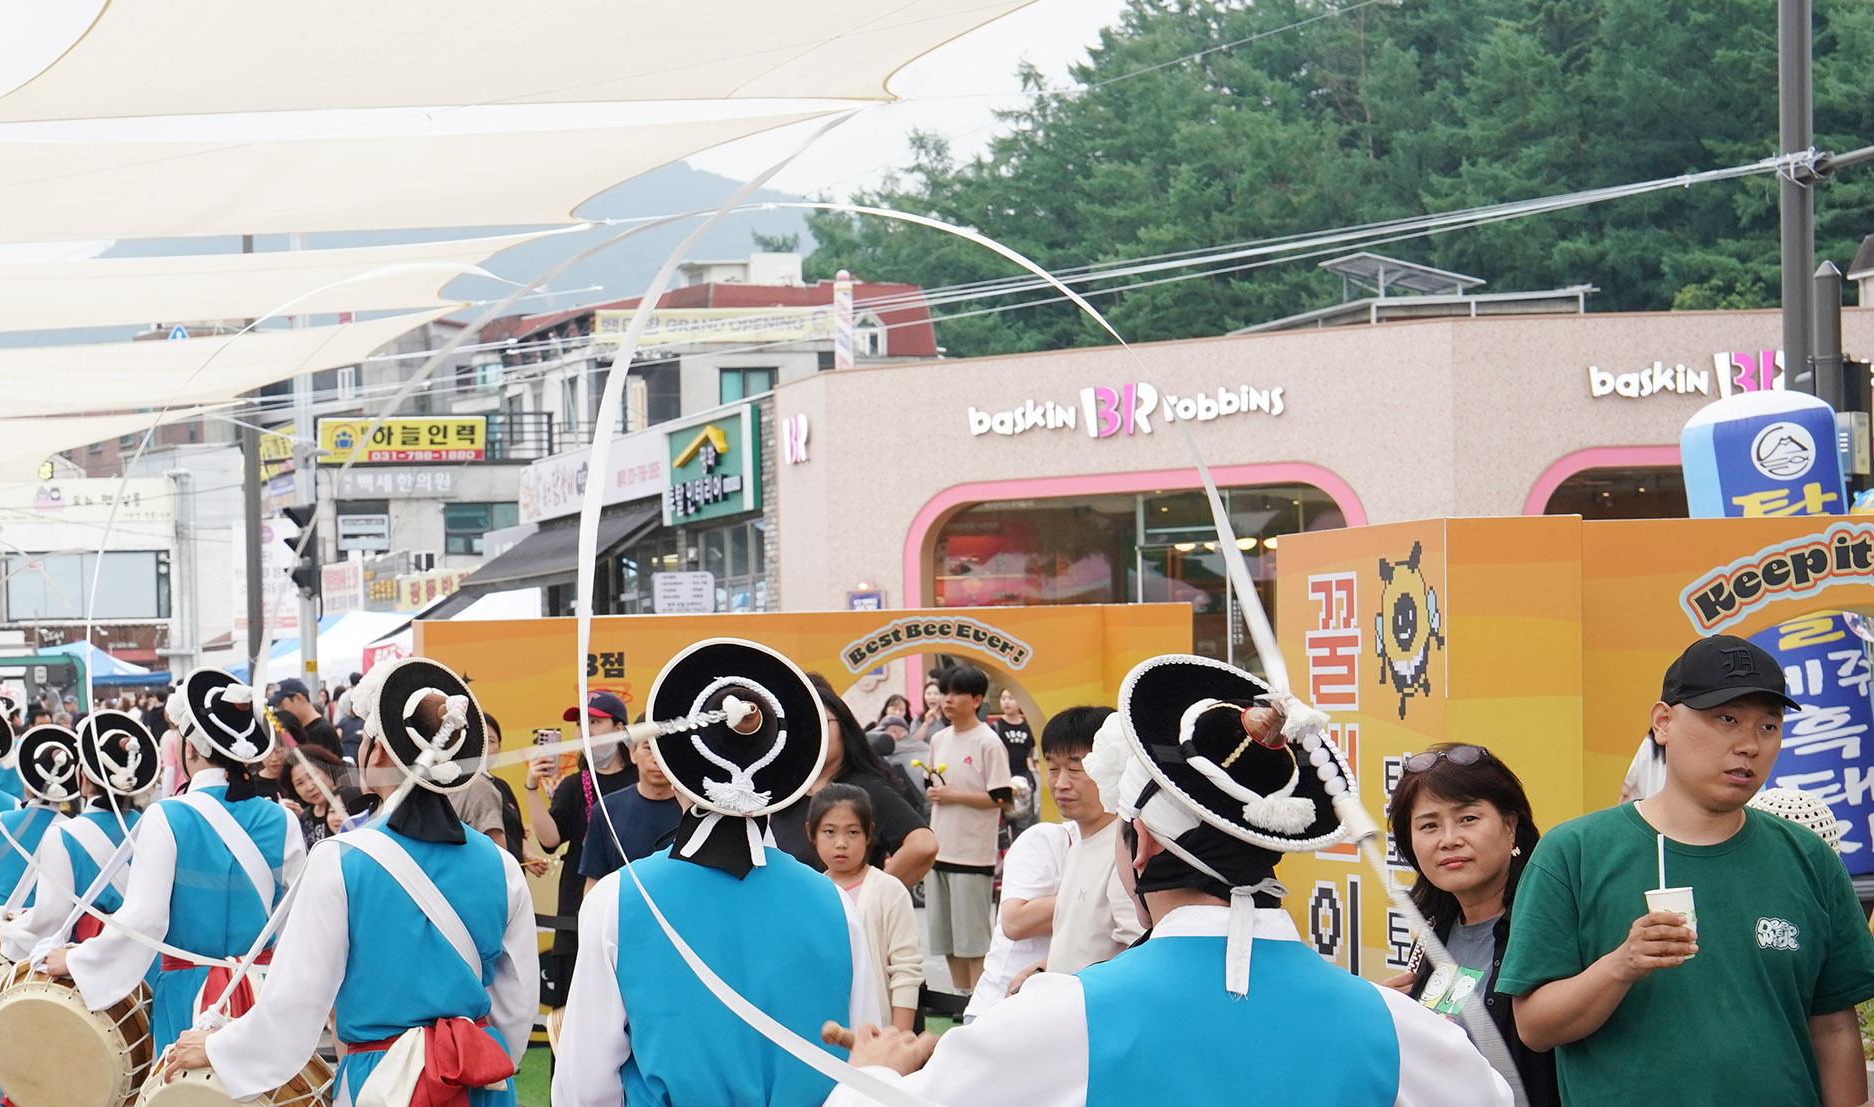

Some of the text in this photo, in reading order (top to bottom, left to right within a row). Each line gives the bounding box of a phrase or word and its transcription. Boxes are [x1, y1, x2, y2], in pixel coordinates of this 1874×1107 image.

[1589, 361, 1709, 398] baskin
[968, 400, 1076, 436] baskin
[1161, 384, 1285, 423] robbins
[372, 423, 476, 447] 하늘인력
[1694, 536, 1873, 622] Keep it
[848, 628, 904, 665] Best
[905, 623, 952, 639] Bee
